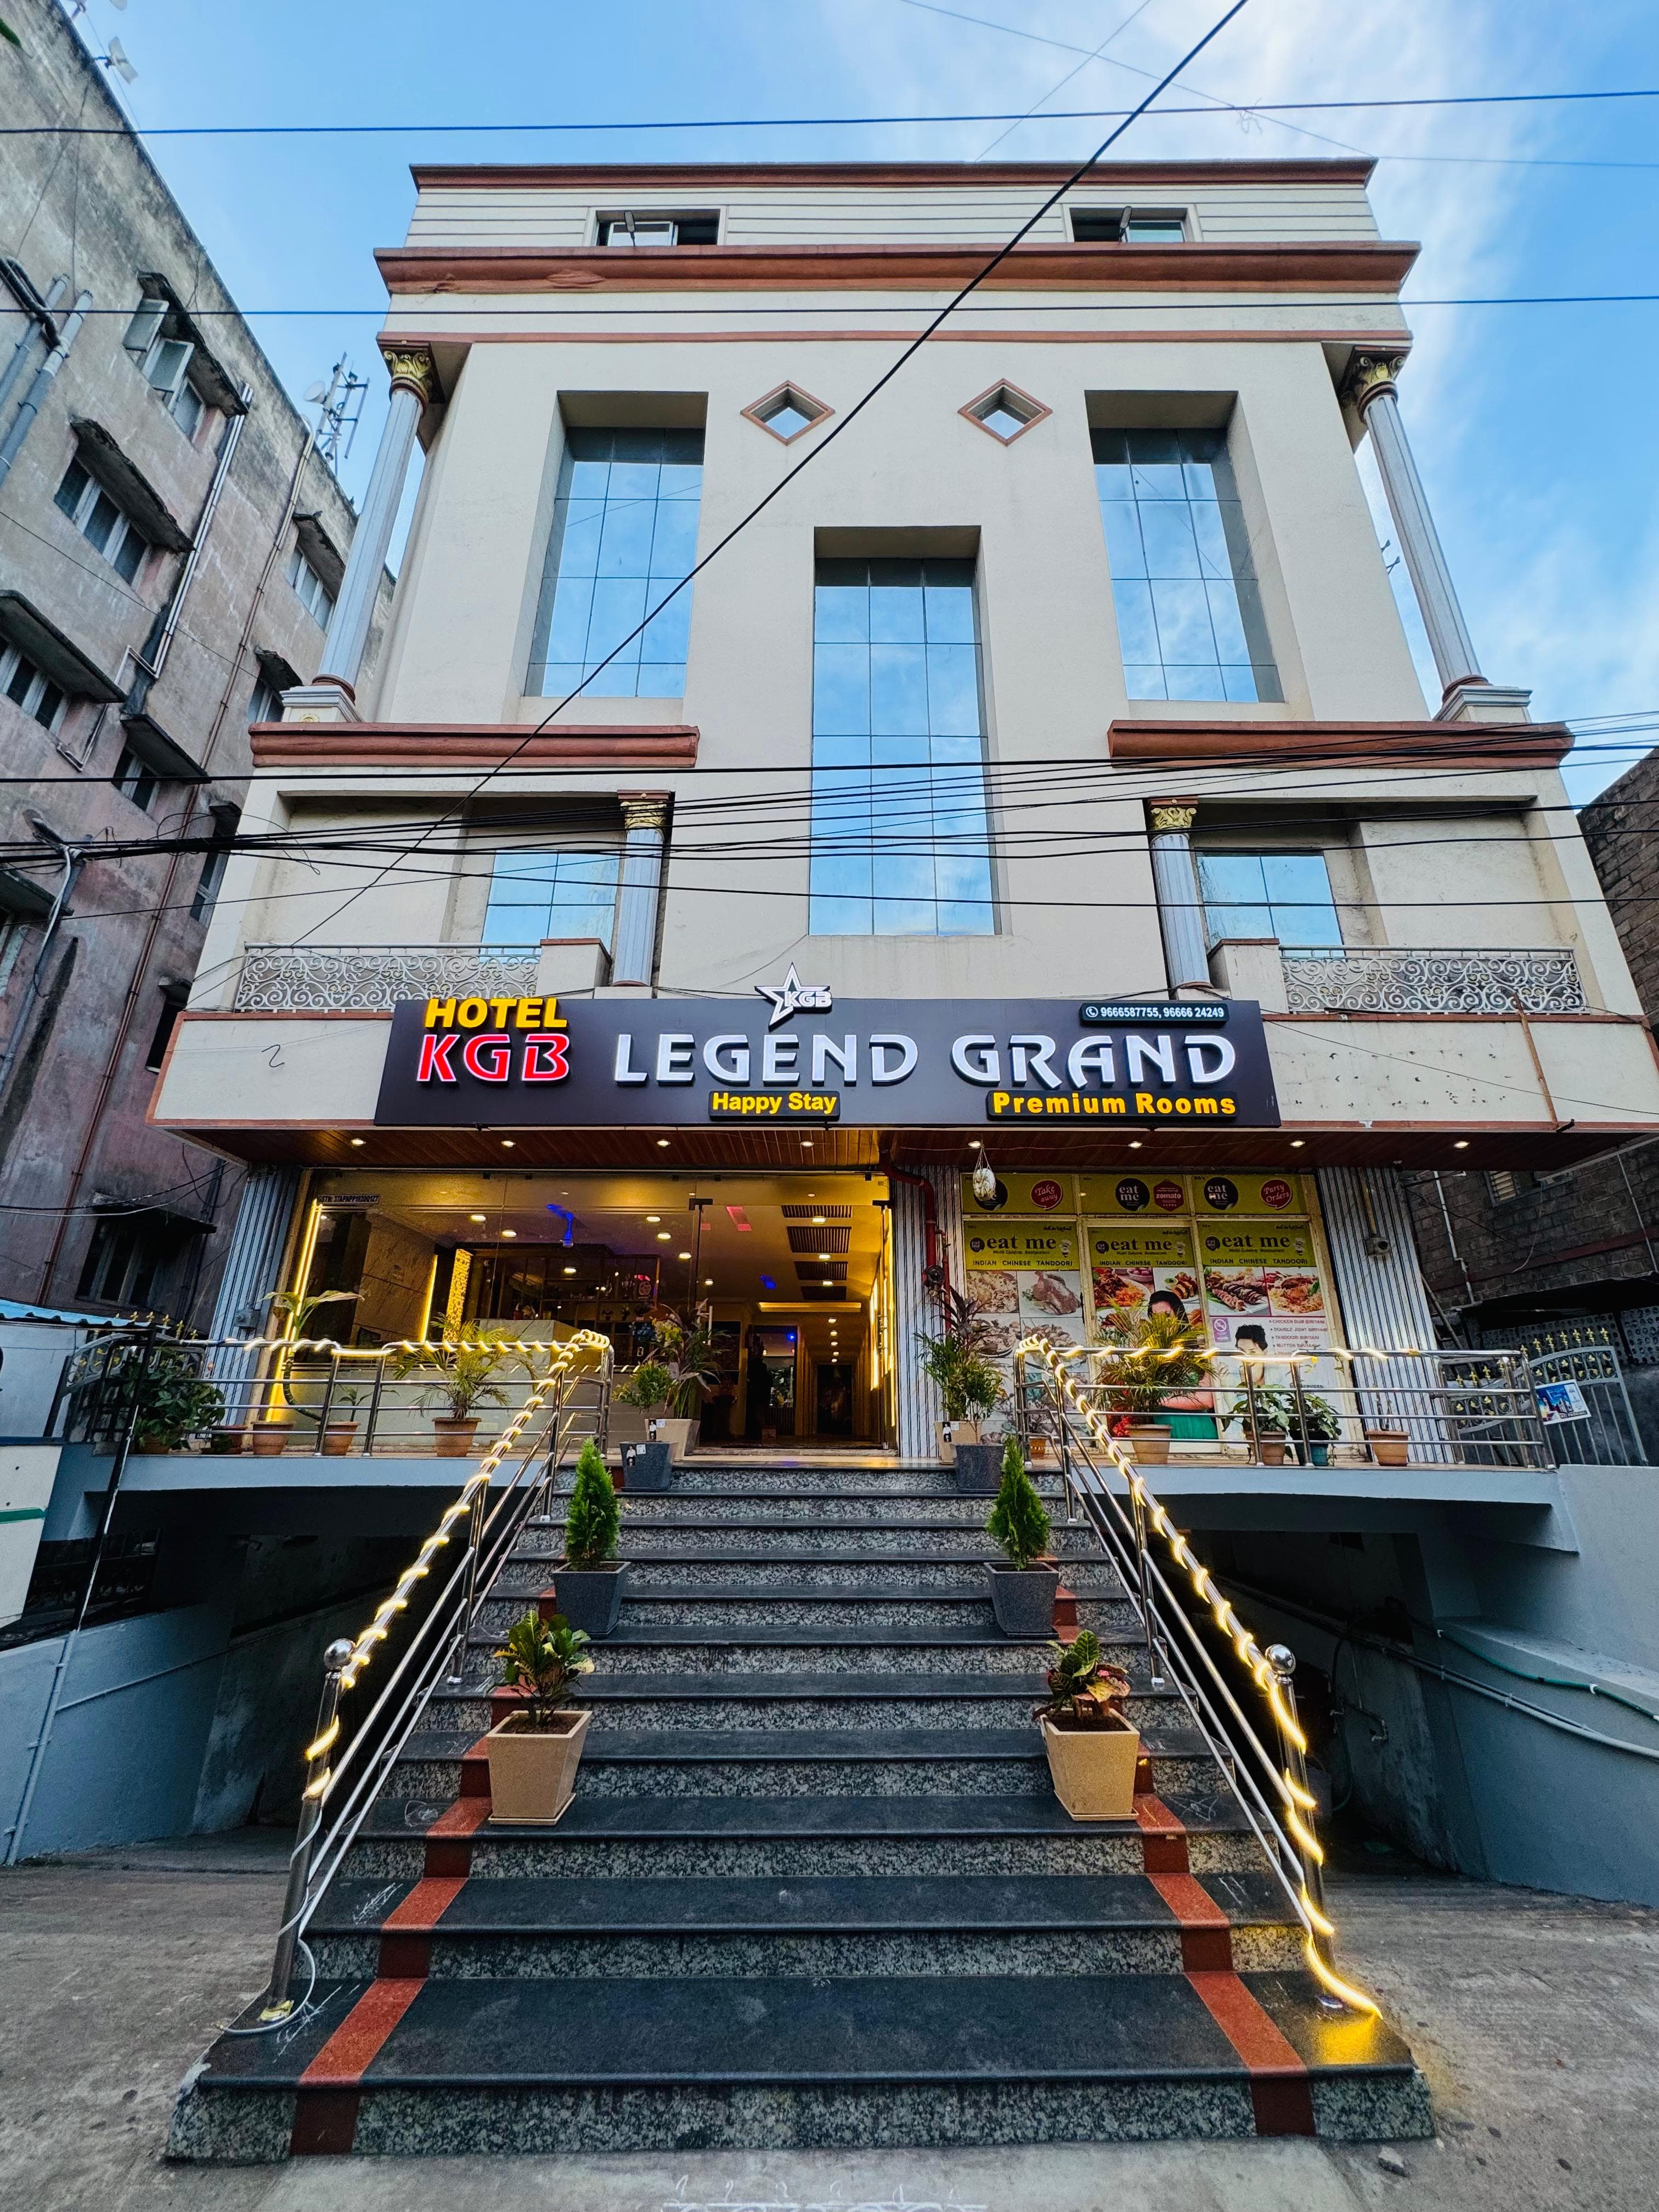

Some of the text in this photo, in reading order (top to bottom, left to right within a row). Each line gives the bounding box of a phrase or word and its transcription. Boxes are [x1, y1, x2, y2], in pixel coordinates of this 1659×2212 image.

[785, 991, 832, 1007] KGB
[425, 997, 567, 1028] HOTEL
[1101, 1007, 1224, 1018] 9666587755, 96666 24249
[416, 1034, 569, 1081] KGB
[614, 1034, 1236, 1089] LEGEND GRAND
[712, 1092, 837, 1114] Happy Stay
[994, 1092, 1237, 1115] Premium Rooms
[1035, 1184, 1056, 1195] Take
[1119, 1185, 1139, 1194] eat
[1207, 1184, 1227, 1193] eat
[1263, 1184, 1285, 1195] Party
[1266, 1190, 1290, 1203] Orders
[987, 1235, 1057, 1249] eat me
[1110, 1238, 1138, 1250] eat
[1145, 1240, 1172, 1251] me
[1222, 1234, 1290, 1248] eat me
